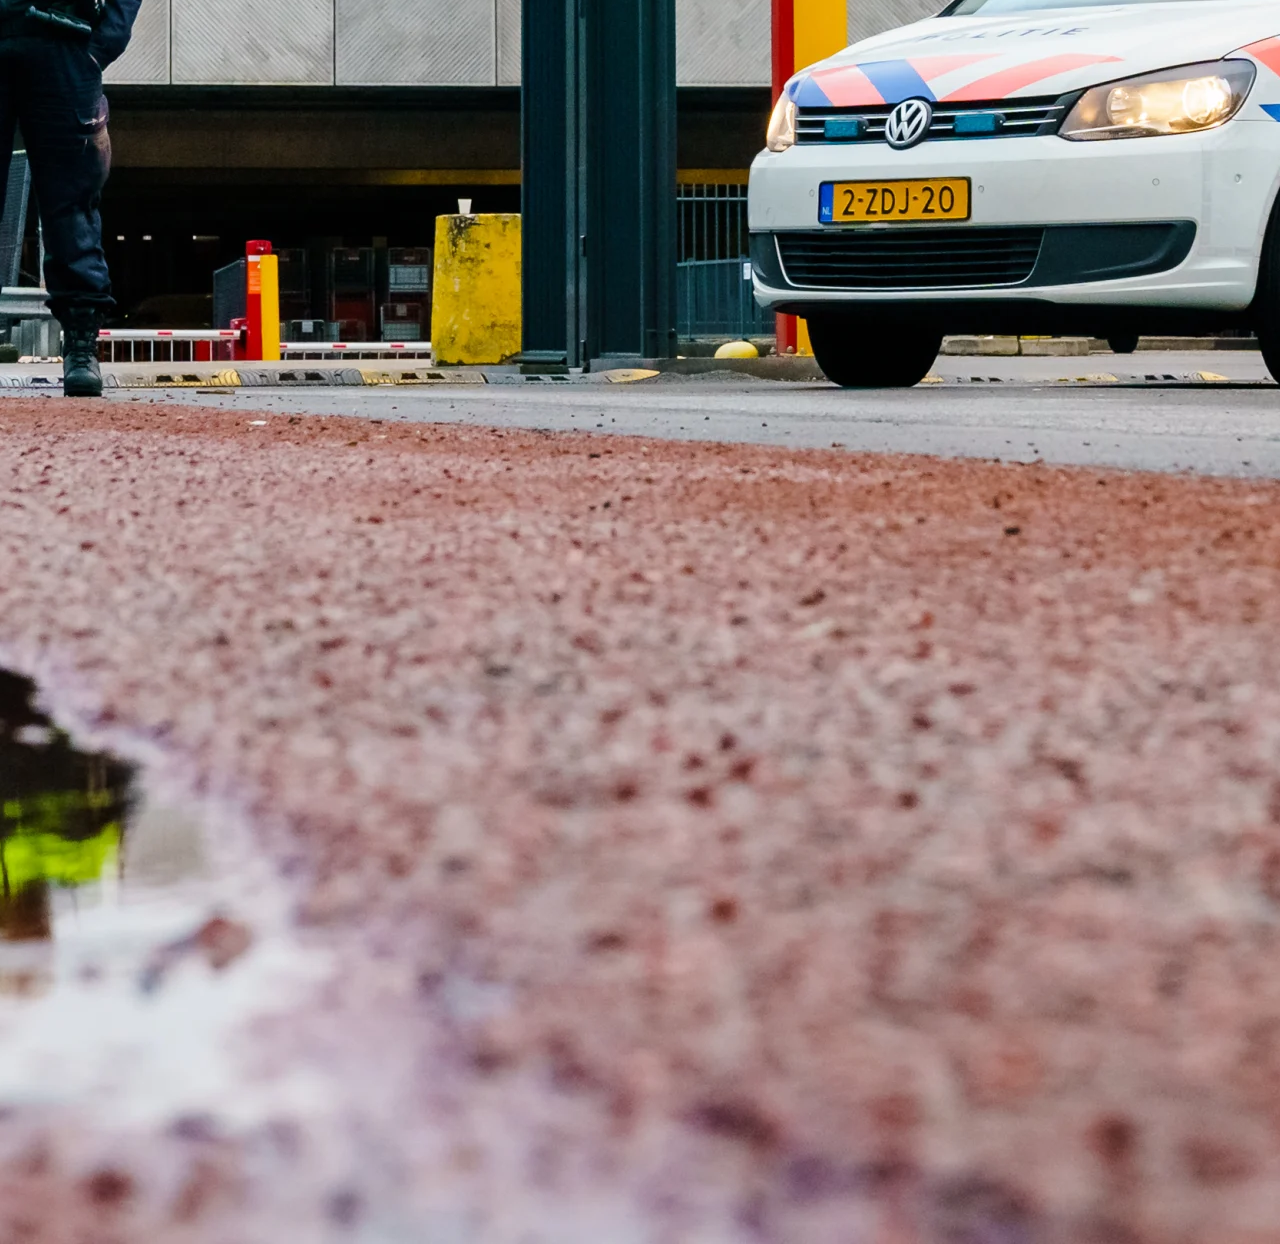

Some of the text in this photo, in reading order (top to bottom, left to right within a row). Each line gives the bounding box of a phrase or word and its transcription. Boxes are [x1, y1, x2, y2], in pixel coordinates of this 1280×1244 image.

[916, 26, 1089, 42] POLITIE
[822, 185, 955, 216] NL 2-ZDJ-20
